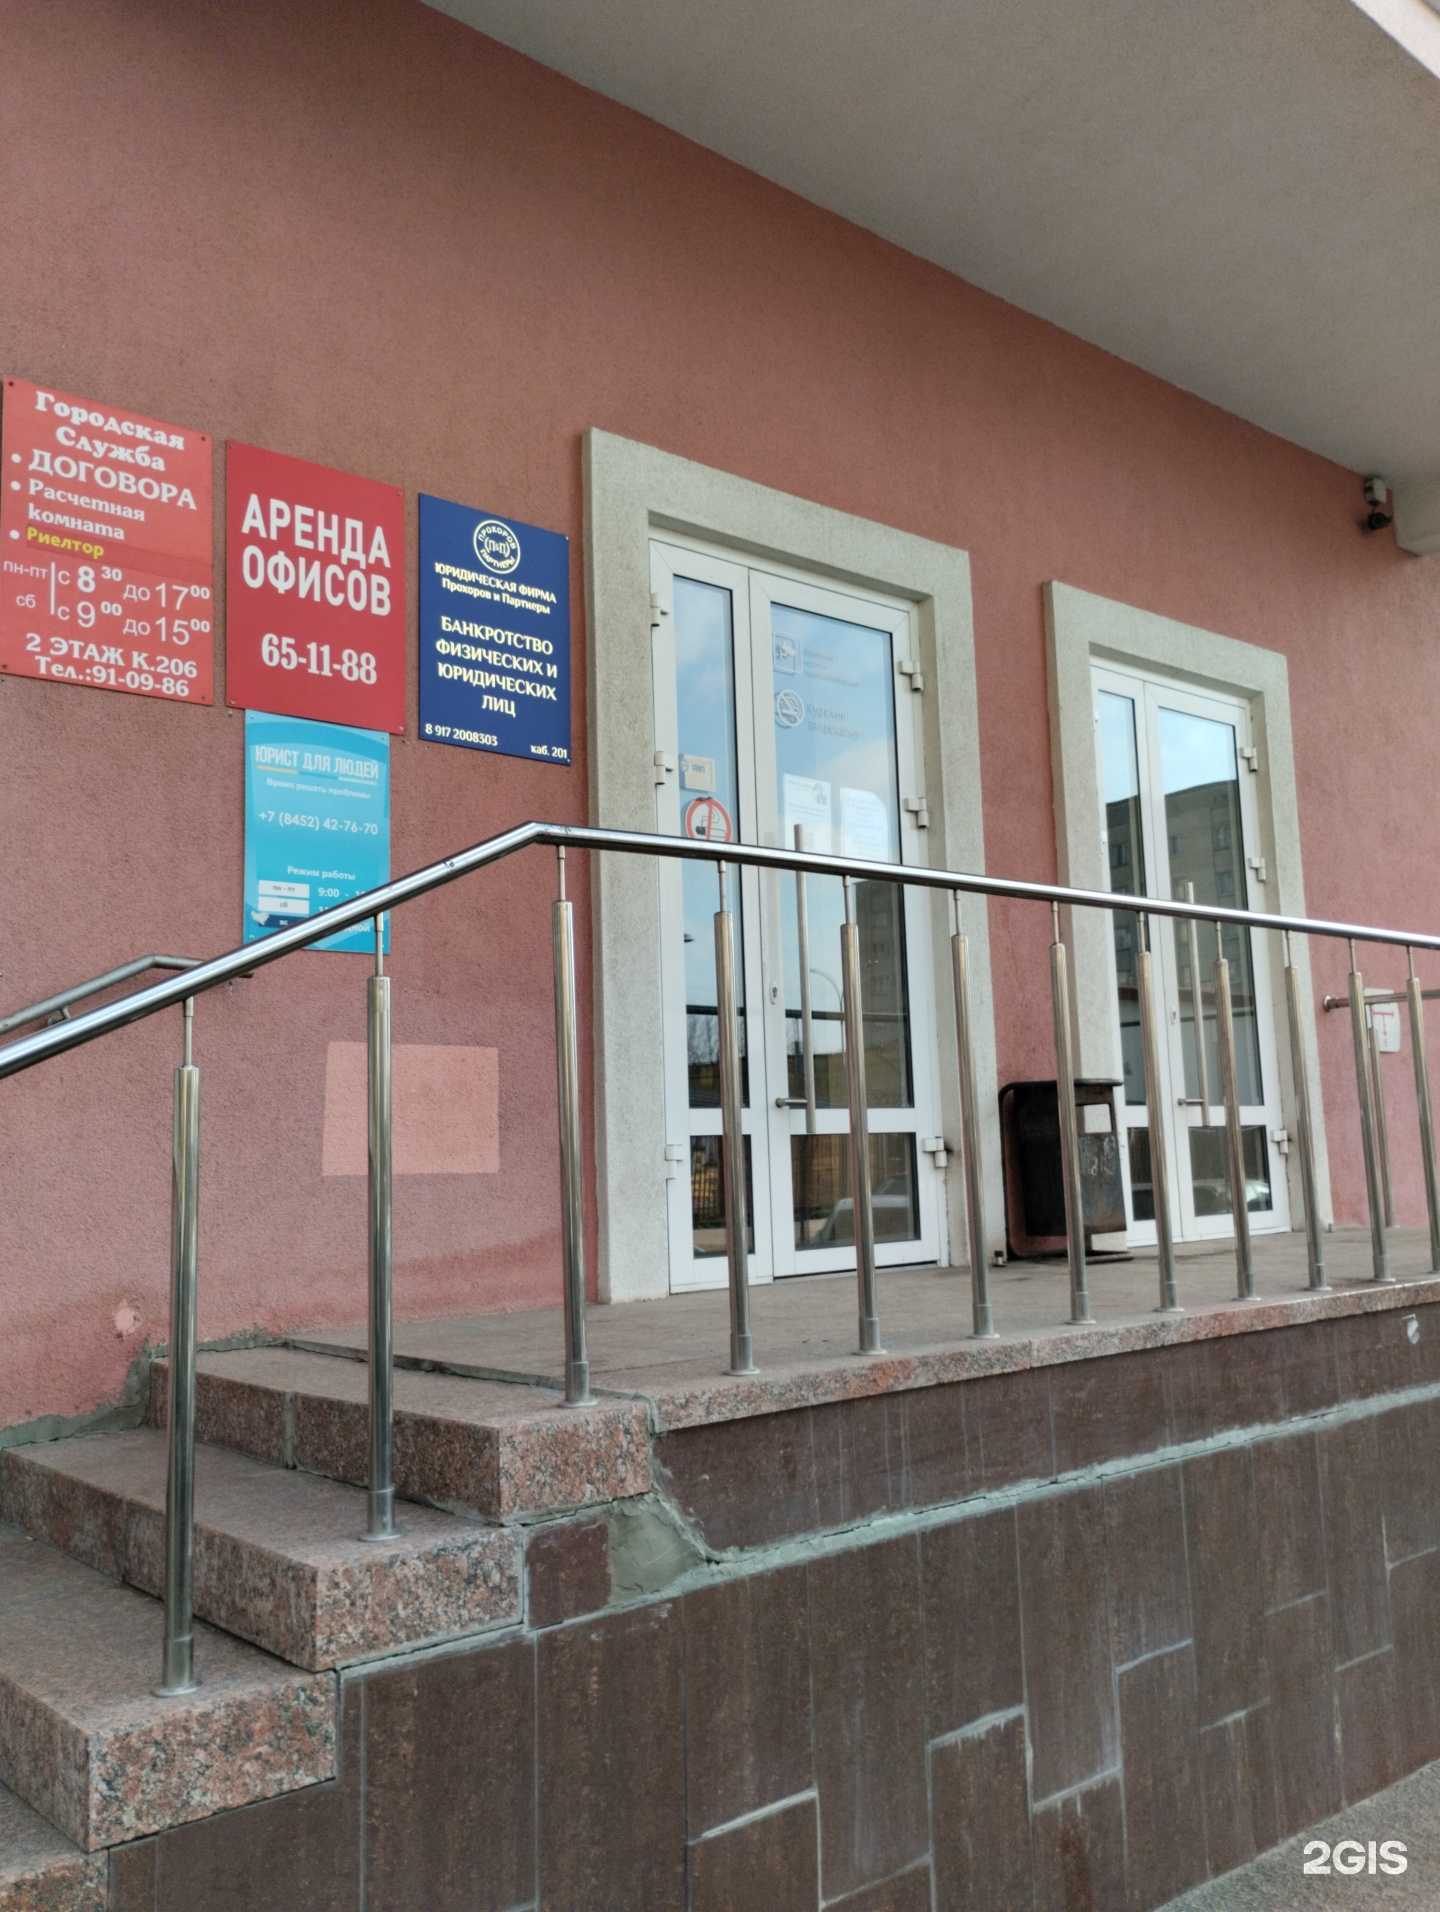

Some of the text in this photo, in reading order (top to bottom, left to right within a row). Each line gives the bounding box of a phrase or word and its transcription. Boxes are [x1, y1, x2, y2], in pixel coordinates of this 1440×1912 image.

[35, 391, 185, 450] Городская
[55, 426, 165, 471] Служба
[28, 449, 197, 510] ДОГОВОРА
[28, 478, 145, 521] Расчетная
[26, 527, 104, 559] Риелтор
[241, 493, 391, 569] АРЕНДА
[242, 545, 391, 617] ОФИСОВ
[434, 562, 557, 604] ЮРИДИЧЕСКАЯ ФИРМА
[442, 577, 551, 615] Прохоров и Партнеры
[16, 594, 36, 609] сб
[25, 632, 41, 652] 2
[50, 637, 125, 666] ЭТАЖ
[441, 616, 554, 655] БАНКРОТСТВО
[261, 633, 378, 685] 65-11-88
[436, 638, 558, 679] ФИЗИЧЕСКИХ И
[438, 662, 557, 701] ЮРИДИЧЕСКИХ
[482, 695, 516, 718] ЛИЦ
[425, 724, 434, 735] 8
[435, 725, 451, 738] 917
[255, 745, 380, 780] ЮРИСТ ДЛЯ ЛЮДЕЙ
[530, 744, 550, 757] каб.
[258, 811, 379, 835] +7 (8452) 42-76-70
[287, 866, 356, 881] Режим работы
[318, 887, 340, 898] 9:00
